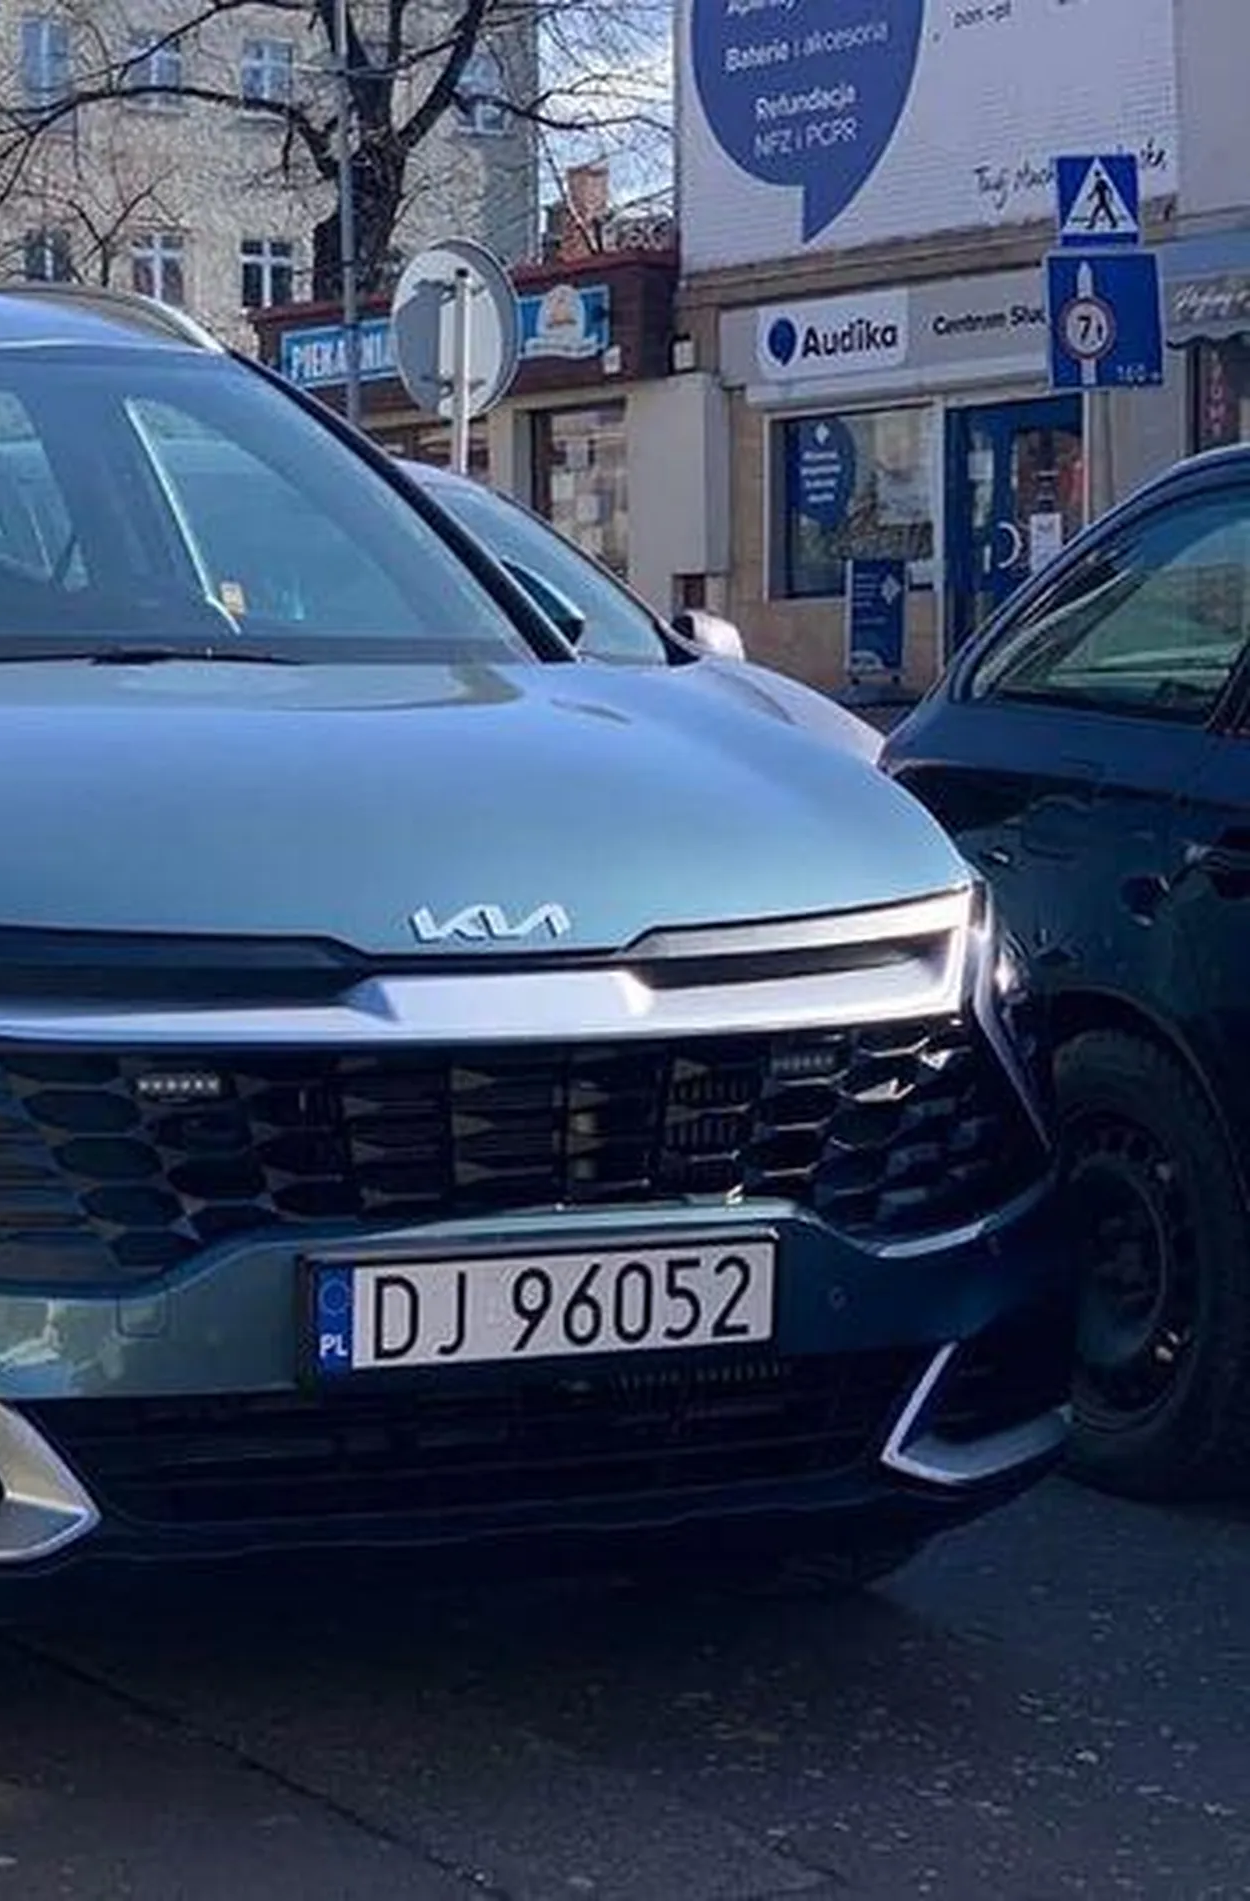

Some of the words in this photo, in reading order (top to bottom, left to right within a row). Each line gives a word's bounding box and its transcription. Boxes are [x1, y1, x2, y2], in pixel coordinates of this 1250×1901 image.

[755, 82, 856, 122] Refundacja
[754, 128, 793, 158] NFZ
[802, 317, 897, 358] Audika
[1076, 315, 1092, 341] 7
[373, 1271, 468, 1361] DJ
[511, 1255, 751, 1352] 96052
[319, 1334, 348, 1358] PL
